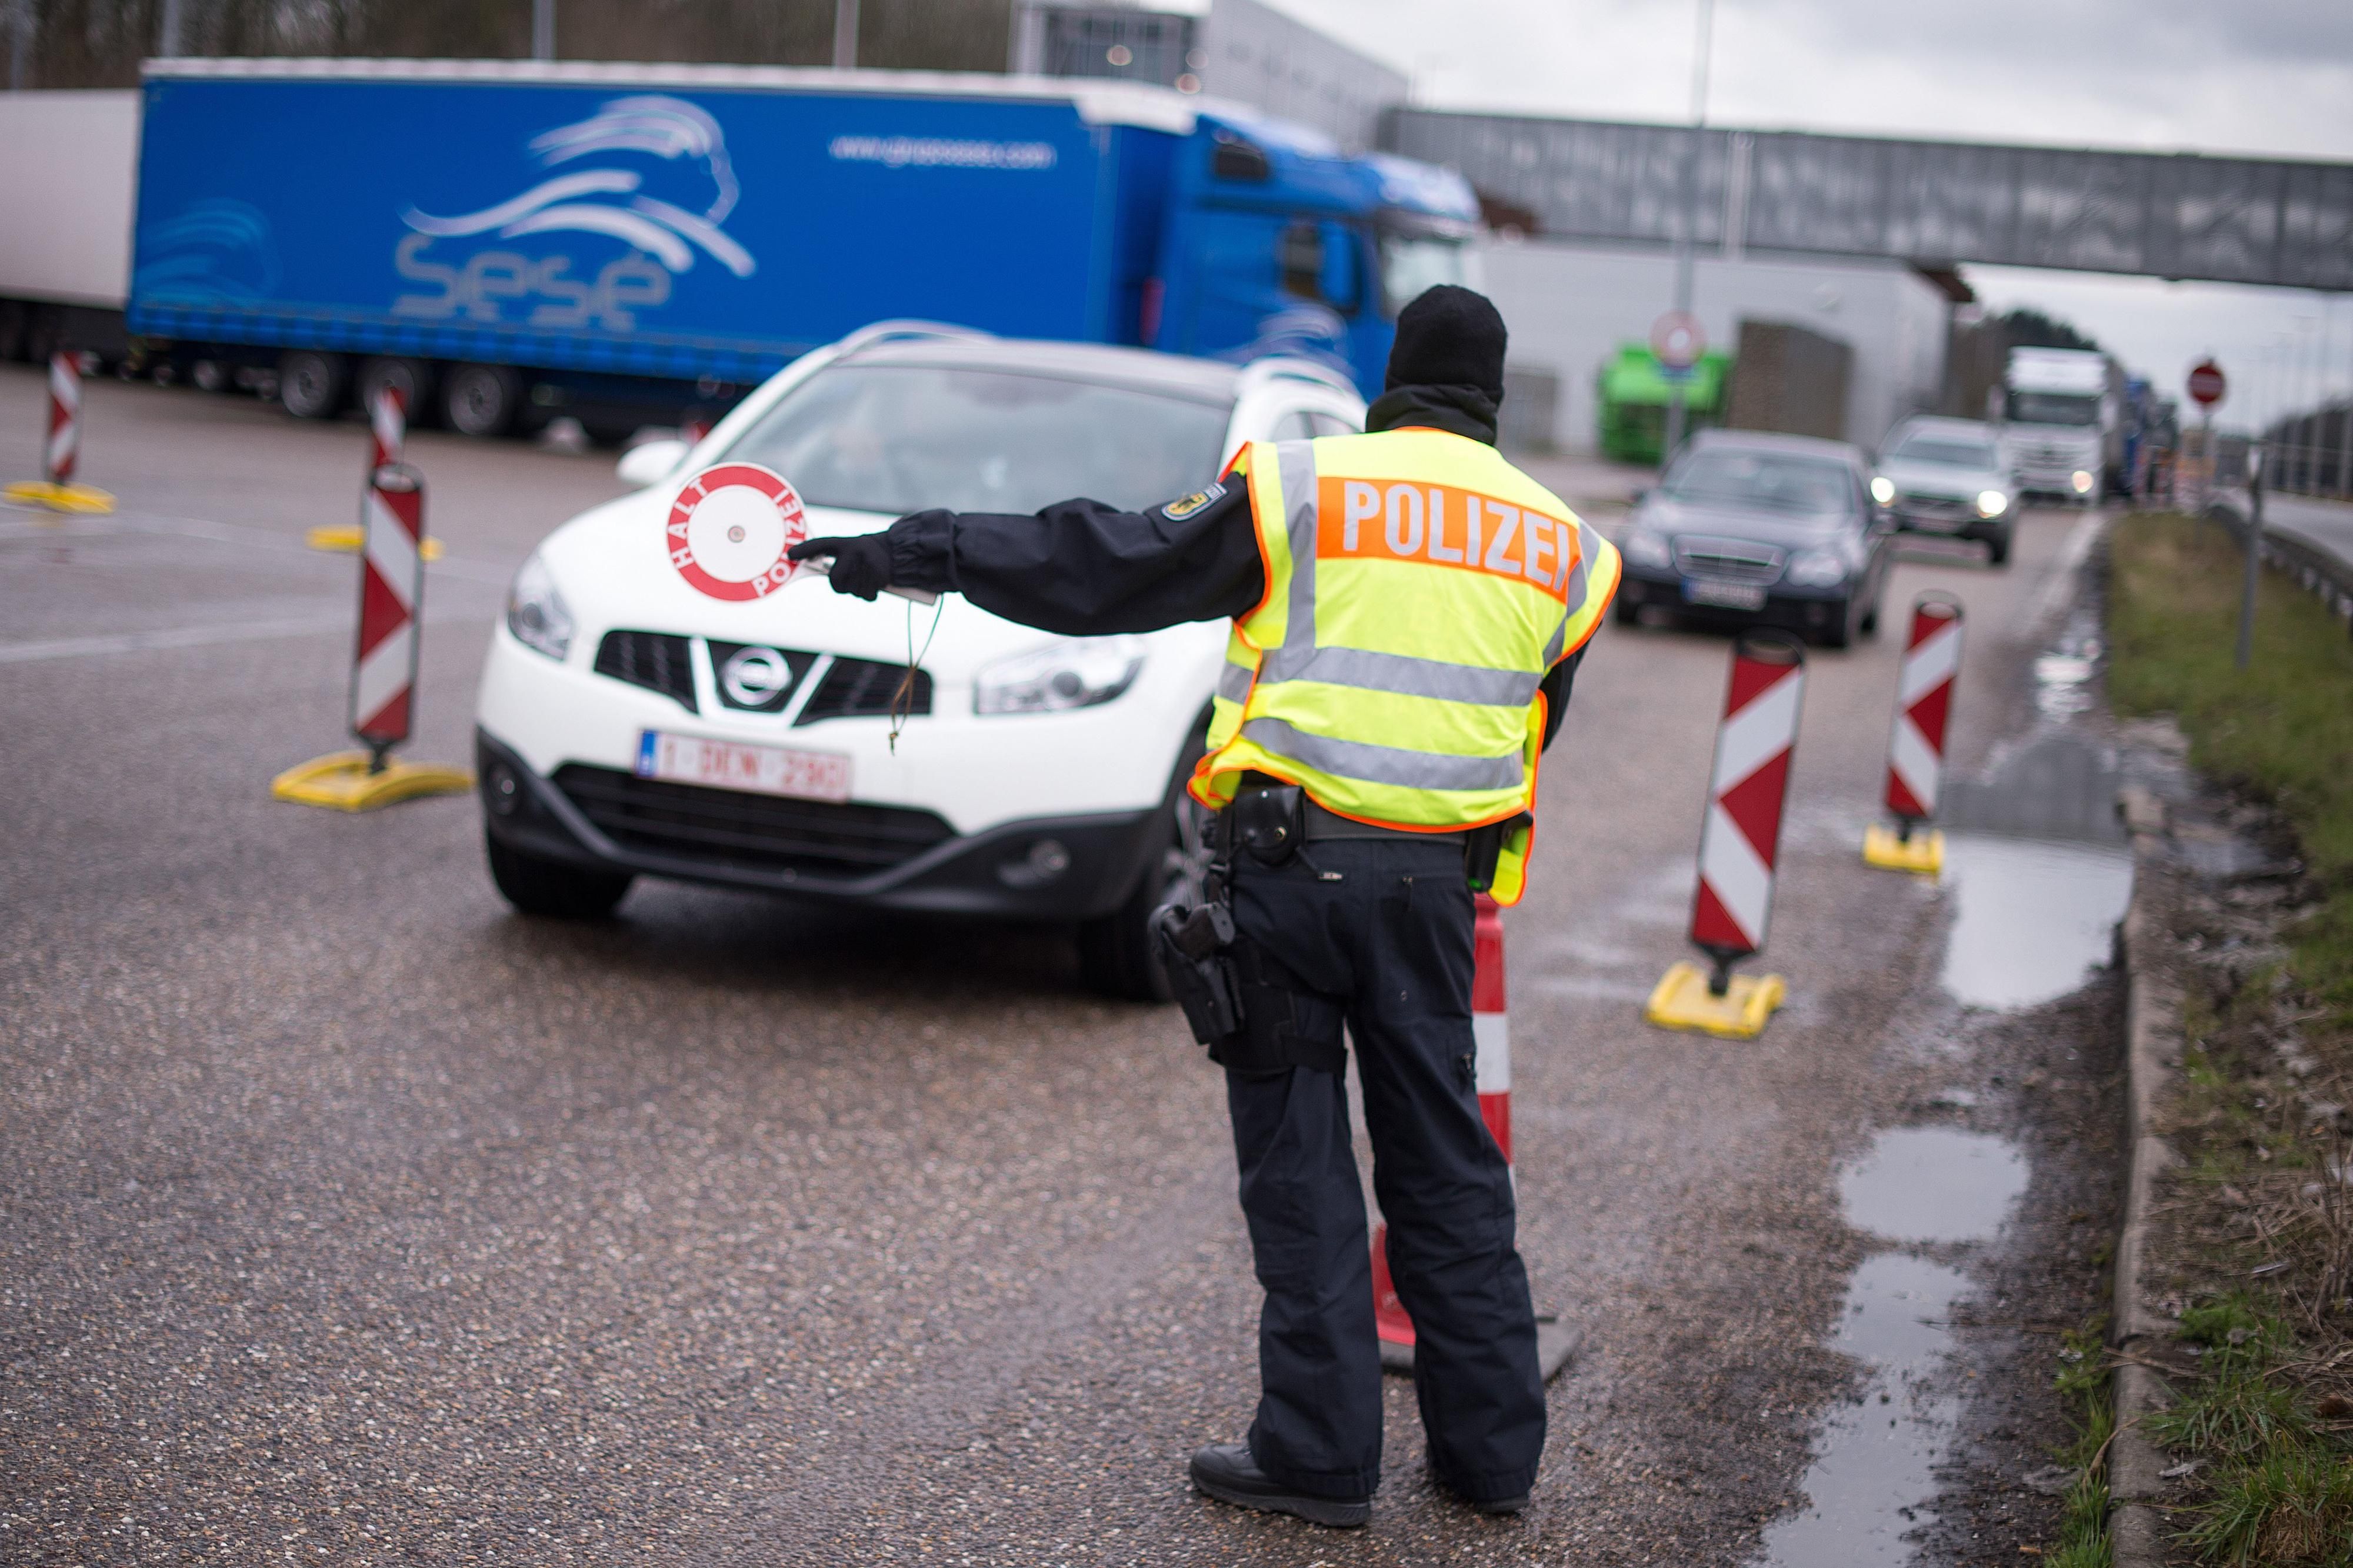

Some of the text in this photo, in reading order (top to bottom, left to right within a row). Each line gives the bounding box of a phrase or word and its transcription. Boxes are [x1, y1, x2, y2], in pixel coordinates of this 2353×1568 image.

[668, 478, 709, 569] HALT
[751, 489, 805, 598] POIZEI
[1344, 481, 1569, 592] POLIZEI
